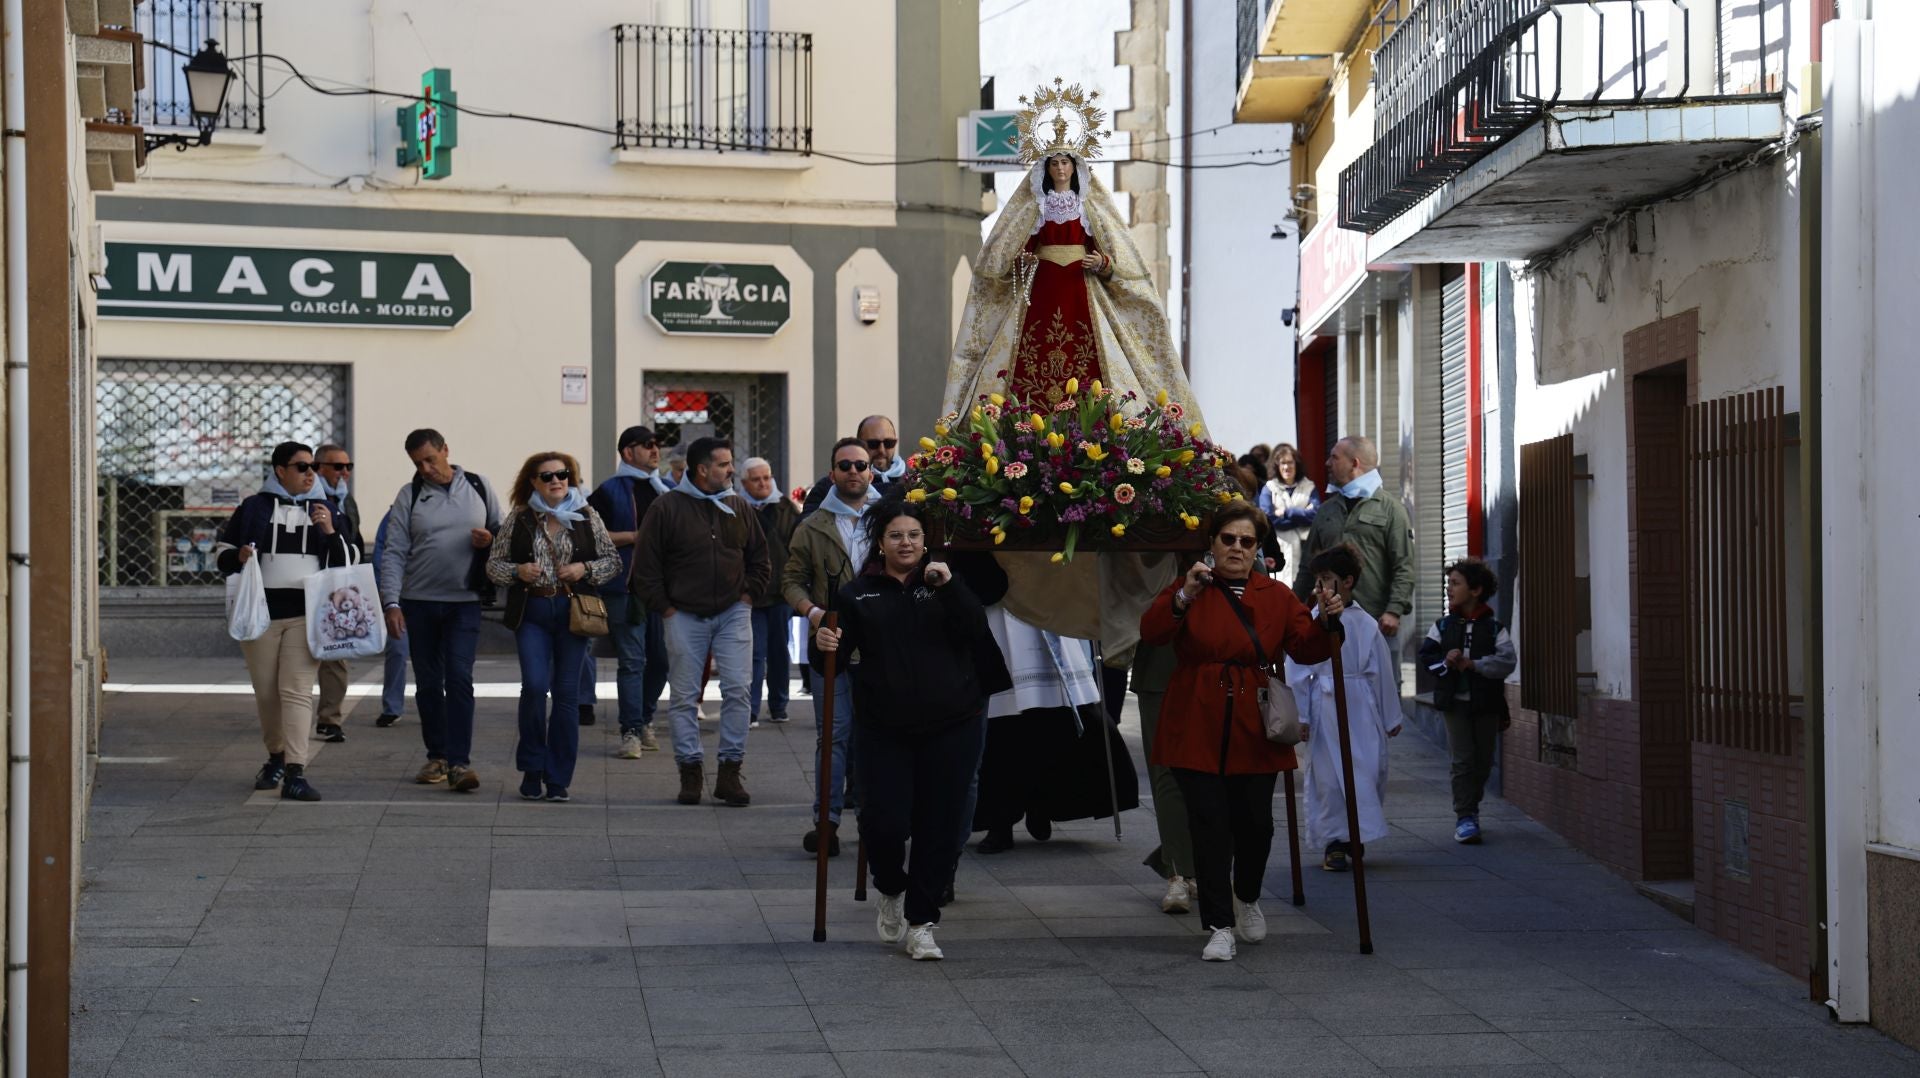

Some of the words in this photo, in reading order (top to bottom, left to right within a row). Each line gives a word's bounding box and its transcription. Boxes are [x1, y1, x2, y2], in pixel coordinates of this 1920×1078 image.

[652, 281, 787, 303] FARMACIA
[290, 300, 360, 315] GARCÍA
[377, 303, 453, 317] MORENO
